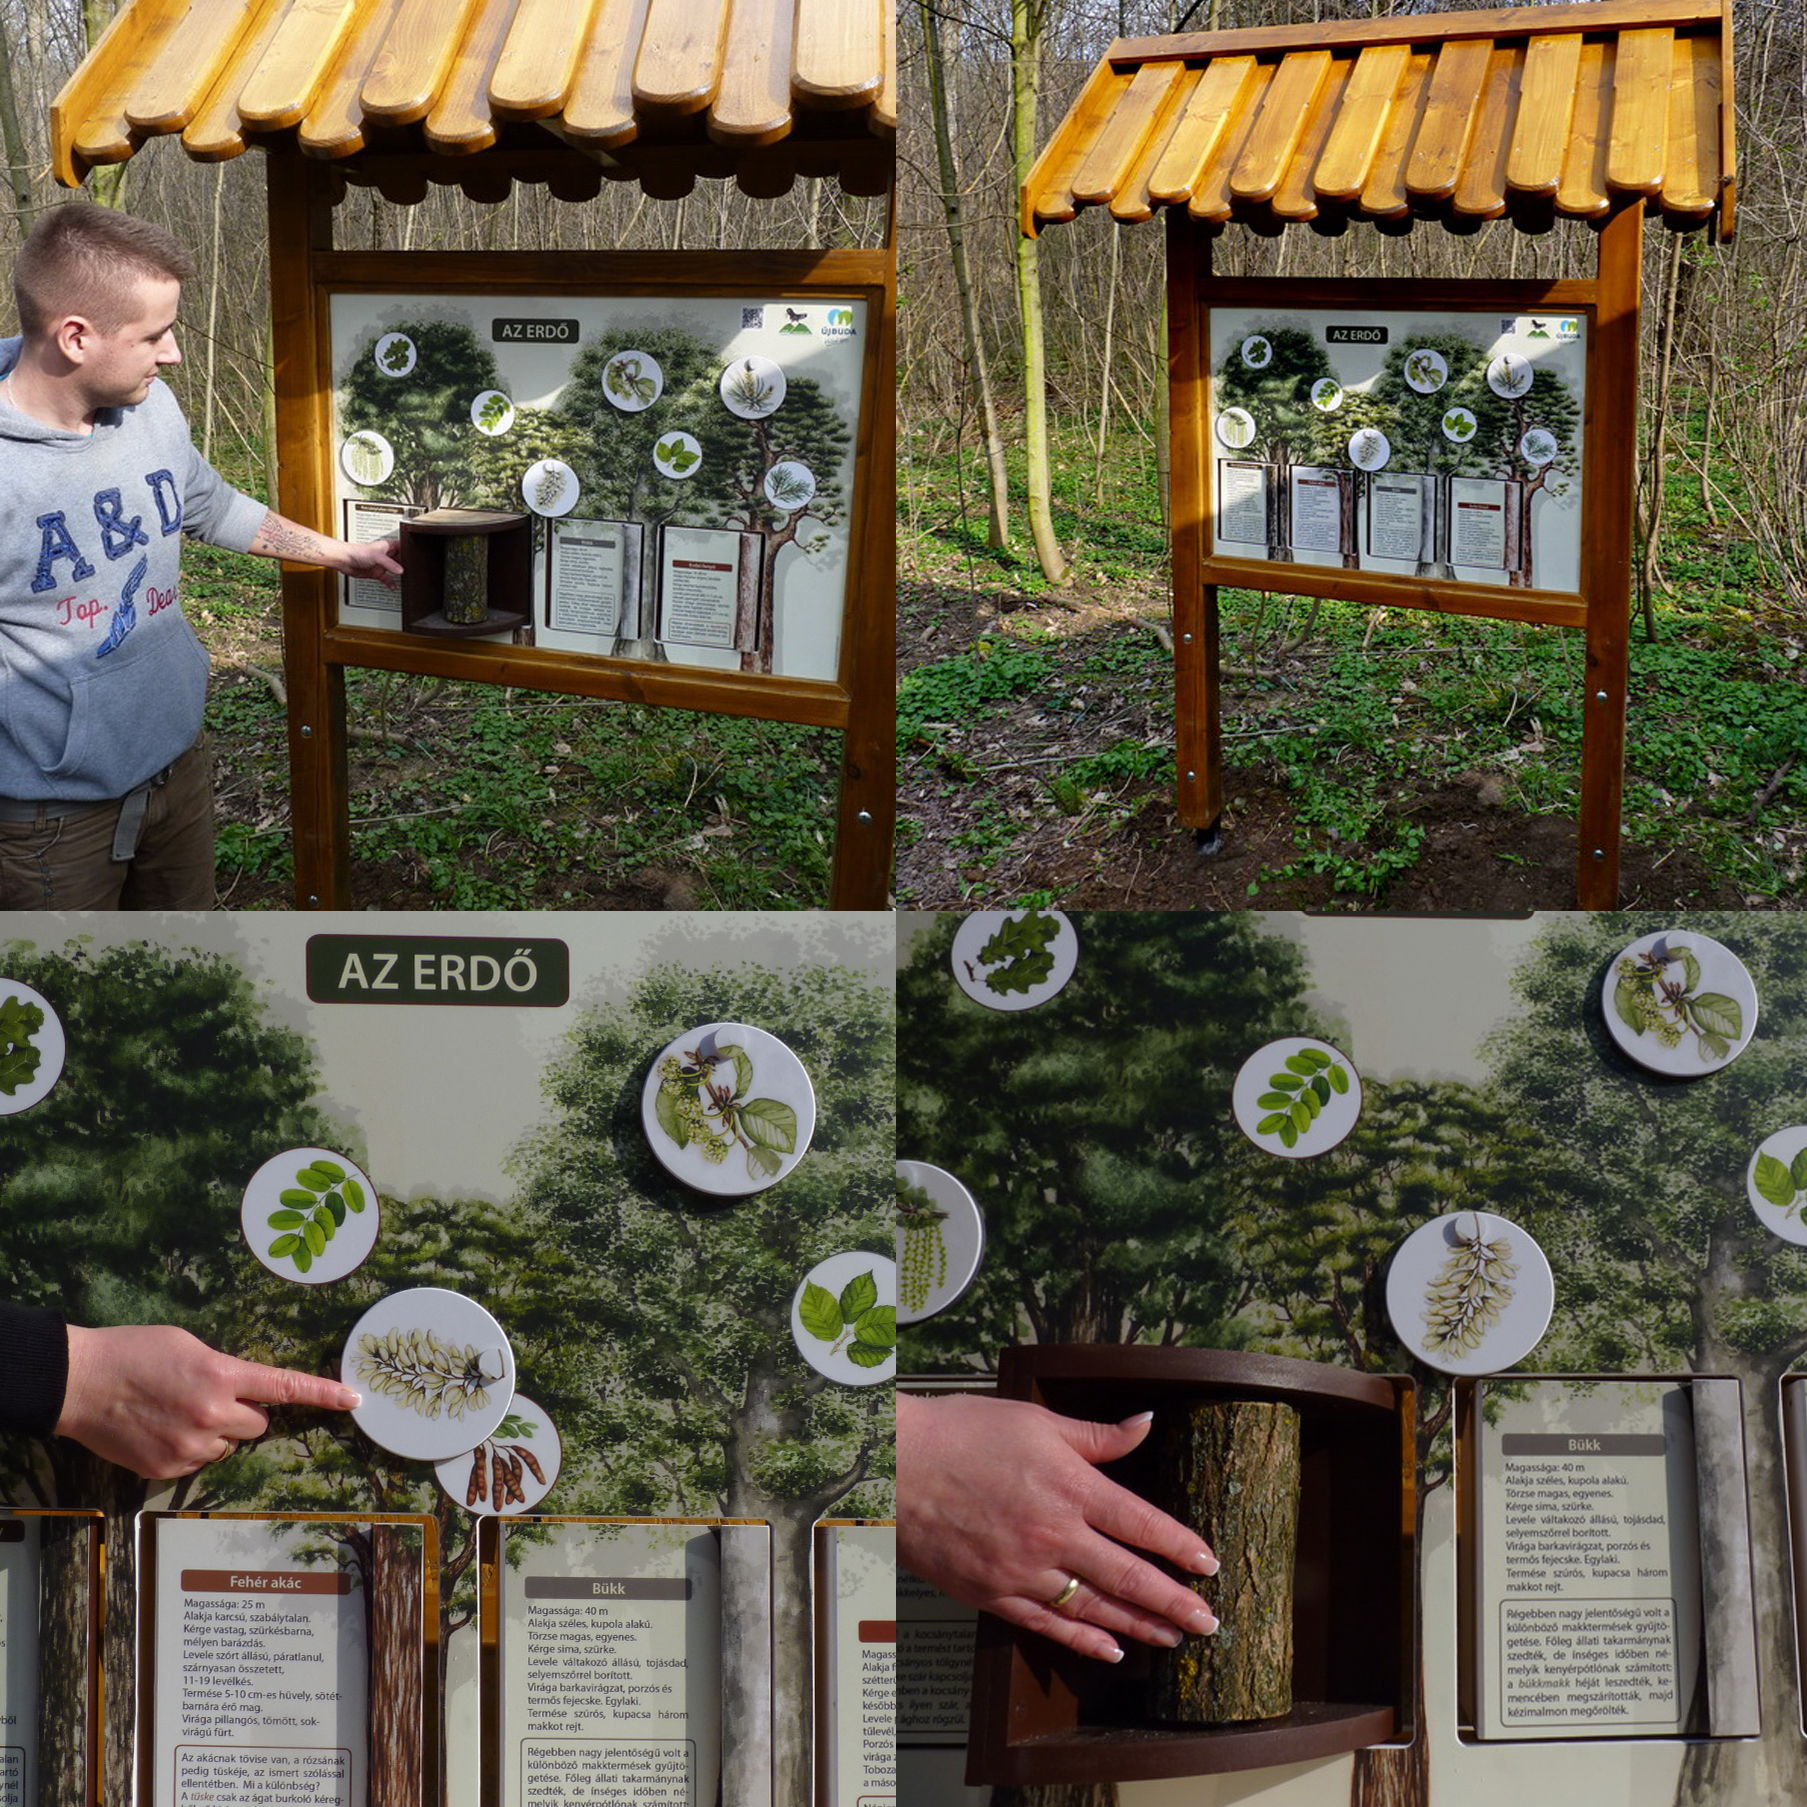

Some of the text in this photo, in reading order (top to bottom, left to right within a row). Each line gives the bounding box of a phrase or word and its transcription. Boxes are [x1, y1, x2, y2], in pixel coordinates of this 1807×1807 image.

[502, 322, 569, 339] AZ ERDŐ
[1333, 330, 1348, 340] AZ
[338, 948, 537, 992] AZ ERDŐ
[1561, 1463, 1574, 1472] 40
[231, 1575, 301, 1588] Fehér akác
[593, 1582, 625, 1594] Bükk
[184, 1598, 239, 1610] Magassága:
[242, 1600, 253, 1609] 25
[528, 1605, 582, 1617] Magassága:
[585, 1607, 597, 1615] 40
[184, 1611, 311, 1625] Alakja karcsú, szabálytalan.
[528, 1618, 653, 1630] Alakja széles, kupola alakú.
[184, 1624, 211, 1635] Kérge
[213, 1626, 246, 1636] vastag,
[184, 1637, 265, 1649] mélyen barázdás.
[527, 1631, 637, 1643] Törzse magas, egyenes.
[528, 1644, 617, 1655] Kérge sima, szürke.
[183, 1650, 324, 1663] Levele szórt állású, páratlanul,
[183, 1663, 236, 1674] szárnyasan
[528, 1657, 688, 1669] Levele váltakozó állású, tojásdad,
[862, 1663, 890, 1674] Alakja
[184, 1676, 253, 1686] 11-19 levélkés.
[528, 1670, 632, 1681] selyemszőrrel borított.
[527, 1683, 672, 1694] Virága barkavirágzat, porzós és
[1507, 1681, 1513, 1689] a
[1575, 1677, 1600, 1690] héját
[182, 1688, 342, 1702] Termése 5-10 cm-es hüvely, sötét-
[862, 1689, 890, 1699] Kérge
[1508, 1692, 1560, 1703] mencében
[1649, 1690, 1673, 1702] majd
[182, 1701, 263, 1714] barnára érő mag.
[528, 1696, 641, 1708] termős fejecske. Egylaki.
[182, 1714, 320, 1726] Virága pillangós, tömött, sok-
[527, 1708, 688, 1720] Termése szúrós, kupacsa három
[863, 1714, 892, 1723] Levele
[182, 1727, 234, 1738] virágú fürt.
[528, 1721, 584, 1733] makkot rejt.
[863, 1740, 893, 1749] Porzós
[181, 1753, 194, 1762] Az
[196, 1753, 236, 1763] akácnak
[239, 1755, 268, 1763] tövise
[271, 1757, 290, 1765] van,
[303, 1756, 345, 1765] rózsának
[528, 1747, 576, 1758] Régebben
[579, 1750, 602, 1759] nagy
[604, 1748, 660, 1759] jelentőségű
[663, 1749, 681, 1757] volt
[863, 1753, 891, 1763] virága
[182, 1766, 209, 1777] pedig
[213, 1767, 250, 1778] tüskéje,
[269, 1768, 299, 1777] ismert
[303, 1768, 344, 1778] szólással
[528, 1760, 688, 1772] különböző makktermések gyűjtö-
[527, 1773, 689, 1785] getése. Főleg állati takarmánynak
[181, 1779, 238, 1789] ellentétben.
[243, 1780, 255, 1789] Mi
[265, 1781, 320, 1792] különbség?
[528, 1786, 688, 1798] szedték, de ínséges időben né-
[181, 1792, 188, 1800] A
[191, 1792, 214, 1801] tüske
[216, 1793, 237, 1801] csak
[252, 1793, 273, 1804] ágat
[275, 1794, 312, 1803] burkoló
[314, 1794, 344, 1806] kéreg-
